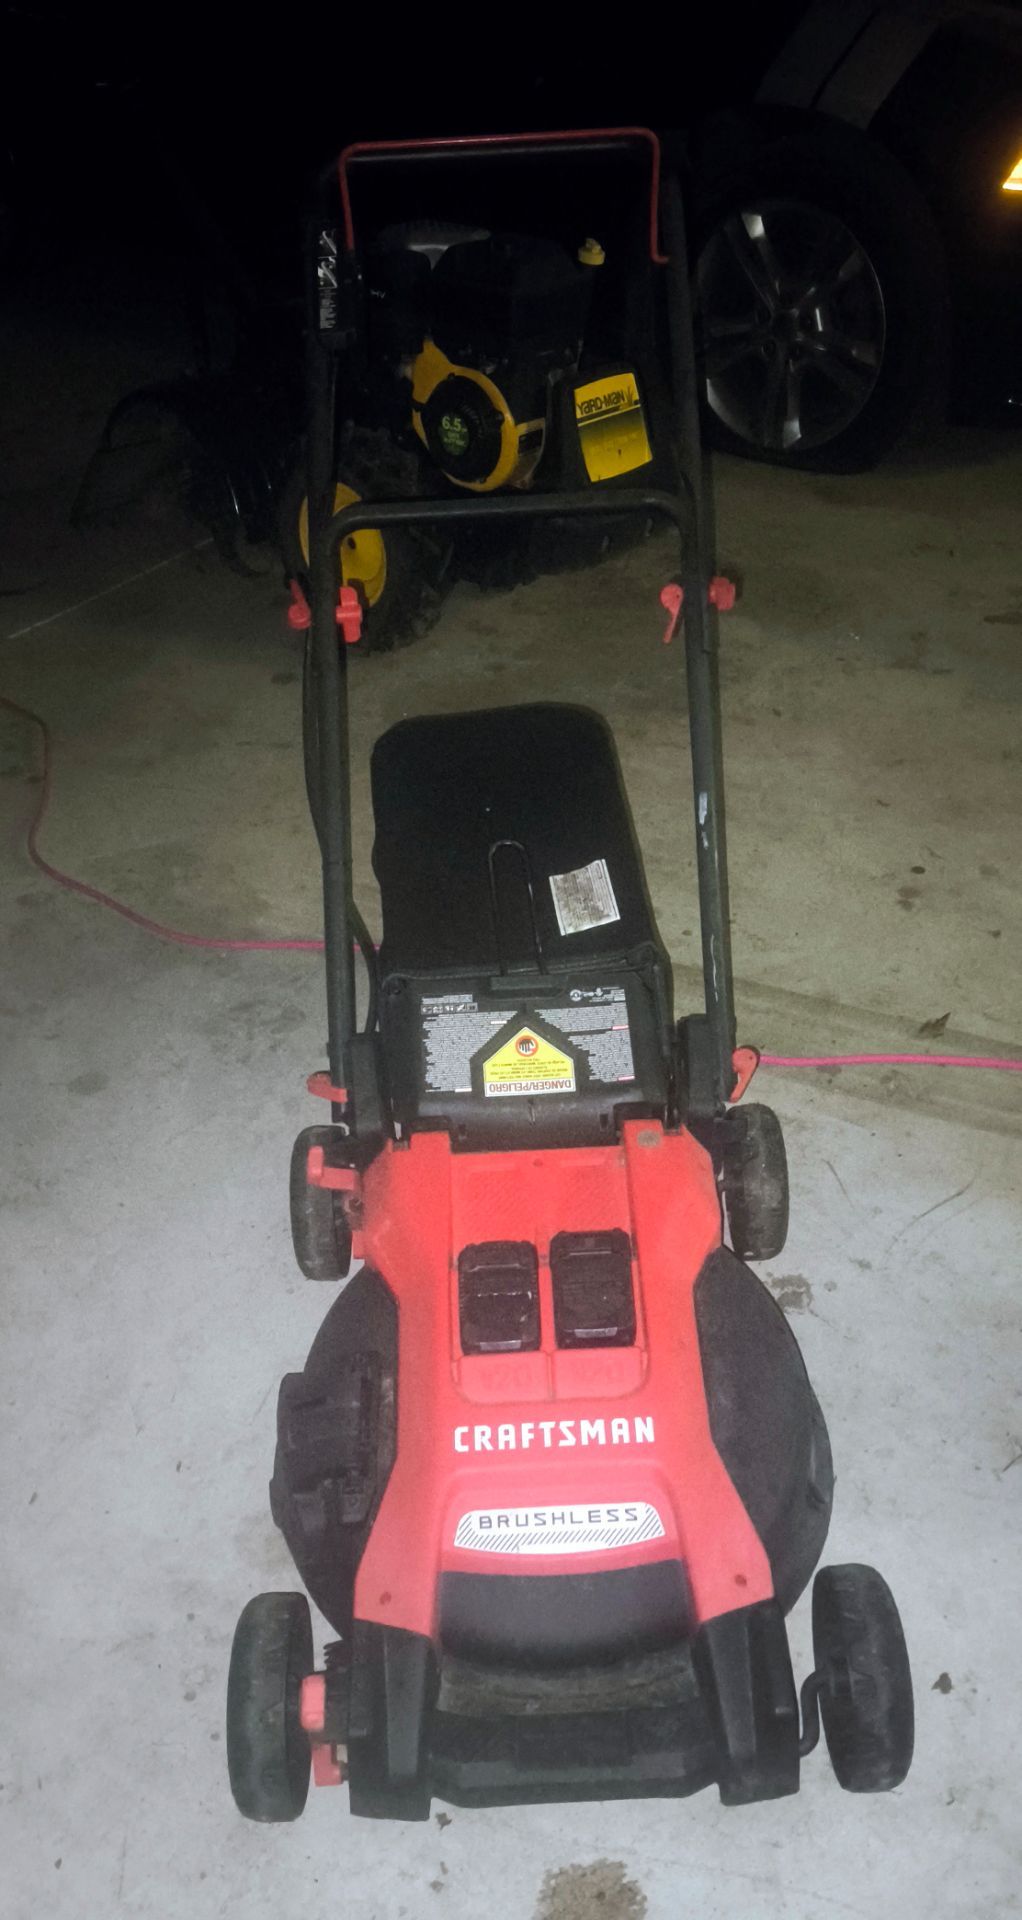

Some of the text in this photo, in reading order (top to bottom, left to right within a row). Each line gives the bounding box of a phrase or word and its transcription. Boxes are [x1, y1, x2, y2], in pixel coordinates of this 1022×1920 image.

[442, 416, 461, 432] 6.5
[489, 1080, 571, 1093] DANGER/PELIGRO
[454, 1416, 655, 1453] CRAFTSMAN
[479, 1507, 638, 1530] BRUSHLESS
